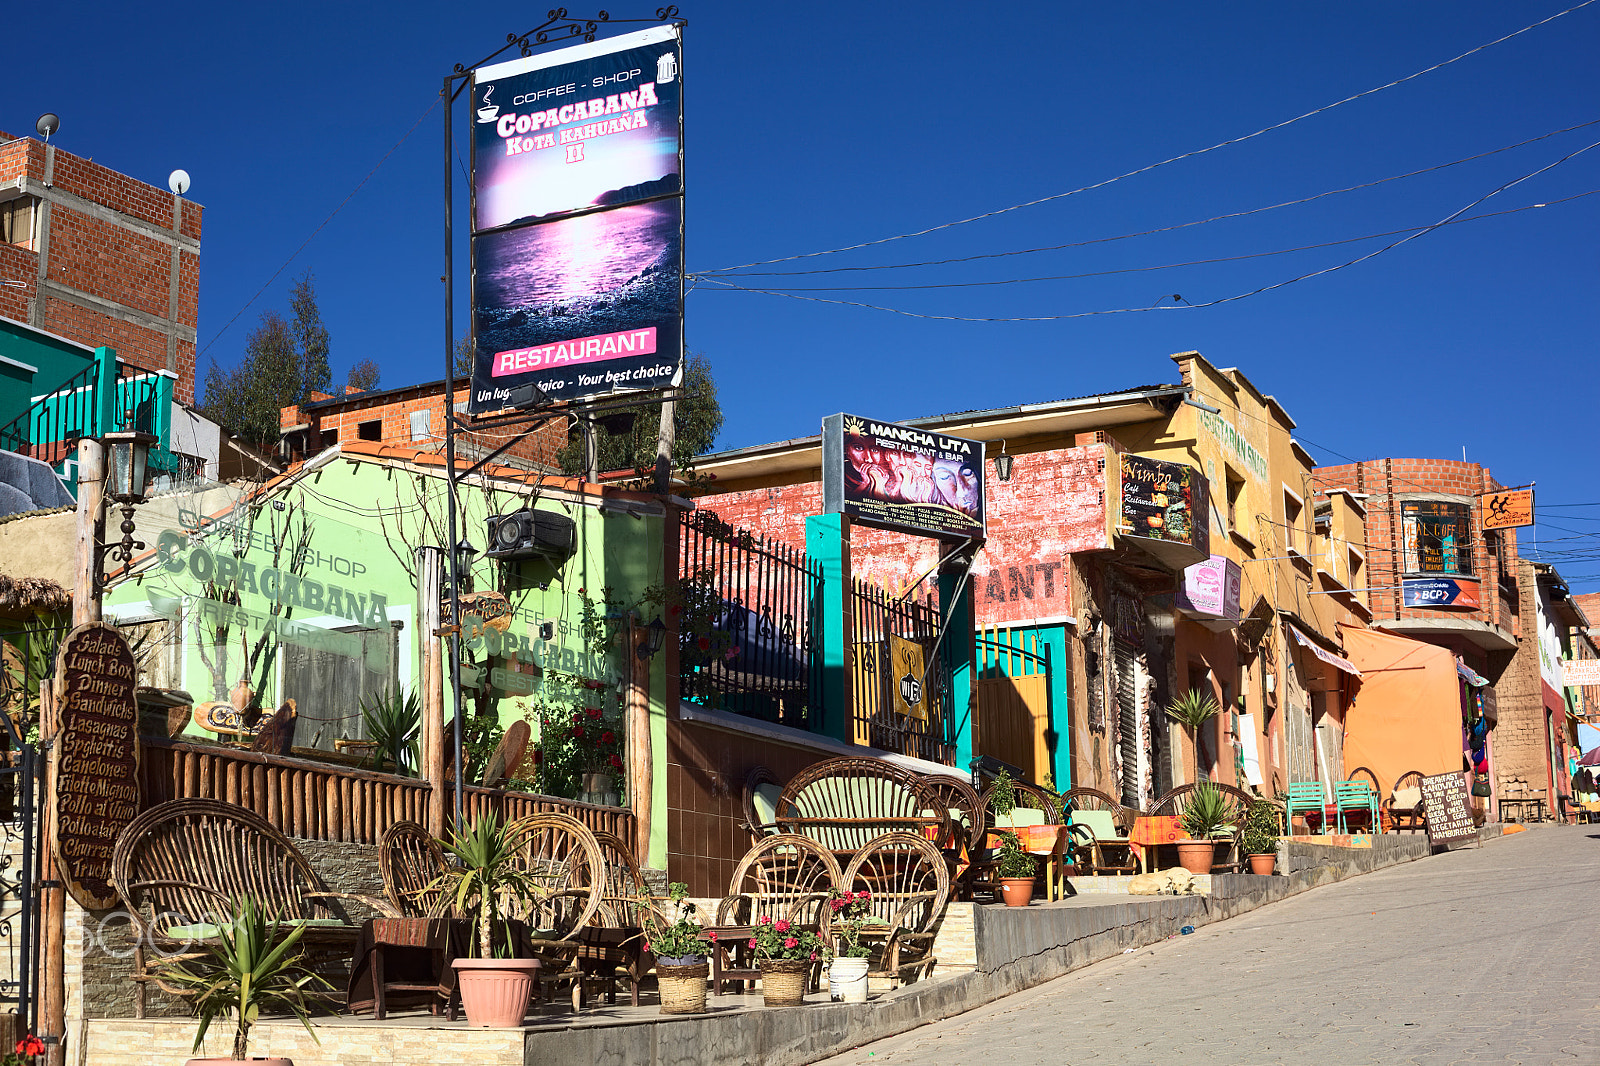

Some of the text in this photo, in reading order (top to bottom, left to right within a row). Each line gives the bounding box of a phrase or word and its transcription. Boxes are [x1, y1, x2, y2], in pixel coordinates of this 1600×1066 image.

[513, 83, 576, 106] COFFEE
[592, 68, 642, 89] SHOP
[497, 82, 659, 138] COPACABANA
[506, 110, 648, 156] KOTA KAHUAÑA
[566, 143, 584, 164] II
[499, 331, 650, 372] RESTAURANT
[477, 390, 492, 402] Un
[578, 371, 604, 387] Your
[605, 369, 631, 384] best
[632, 364, 672, 380] choice
[870, 423, 971, 455] MANKHA UTA
[875, 438, 964, 462] RESTAURANT & BAR
[1123, 461, 1172, 485] Nimbo
[1124, 494, 1158, 508] Restaurant
[1124, 505, 1137, 516] Bar
[178, 509, 279, 555] COFFEE
[299, 546, 366, 579] SHOP
[157, 529, 391, 633] COPACABANA
[1422, 590, 1443, 599] BCP
[476, 595, 545, 627] COFFEE
[76, 633, 121, 657] Salads
[462, 614, 620, 684] COPACABANA
[68, 653, 132, 680] Lunch Box
[77, 674, 128, 698] Dinner
[68, 713, 128, 742] Lasagnas
[62, 756, 128, 779] Canelones
[1422, 773, 1458, 785] BREAKFAST
[1421, 778, 1465, 794] SANDWICHS
[60, 793, 134, 820] Pollo al Vino
[1452, 811, 1468, 820] EGGS
[60, 815, 92, 836] Pollo
[1430, 817, 1474, 832] VEGETARIAN
[1432, 825, 1477, 840] HAMBURGERS
[64, 838, 115, 859] Churras
